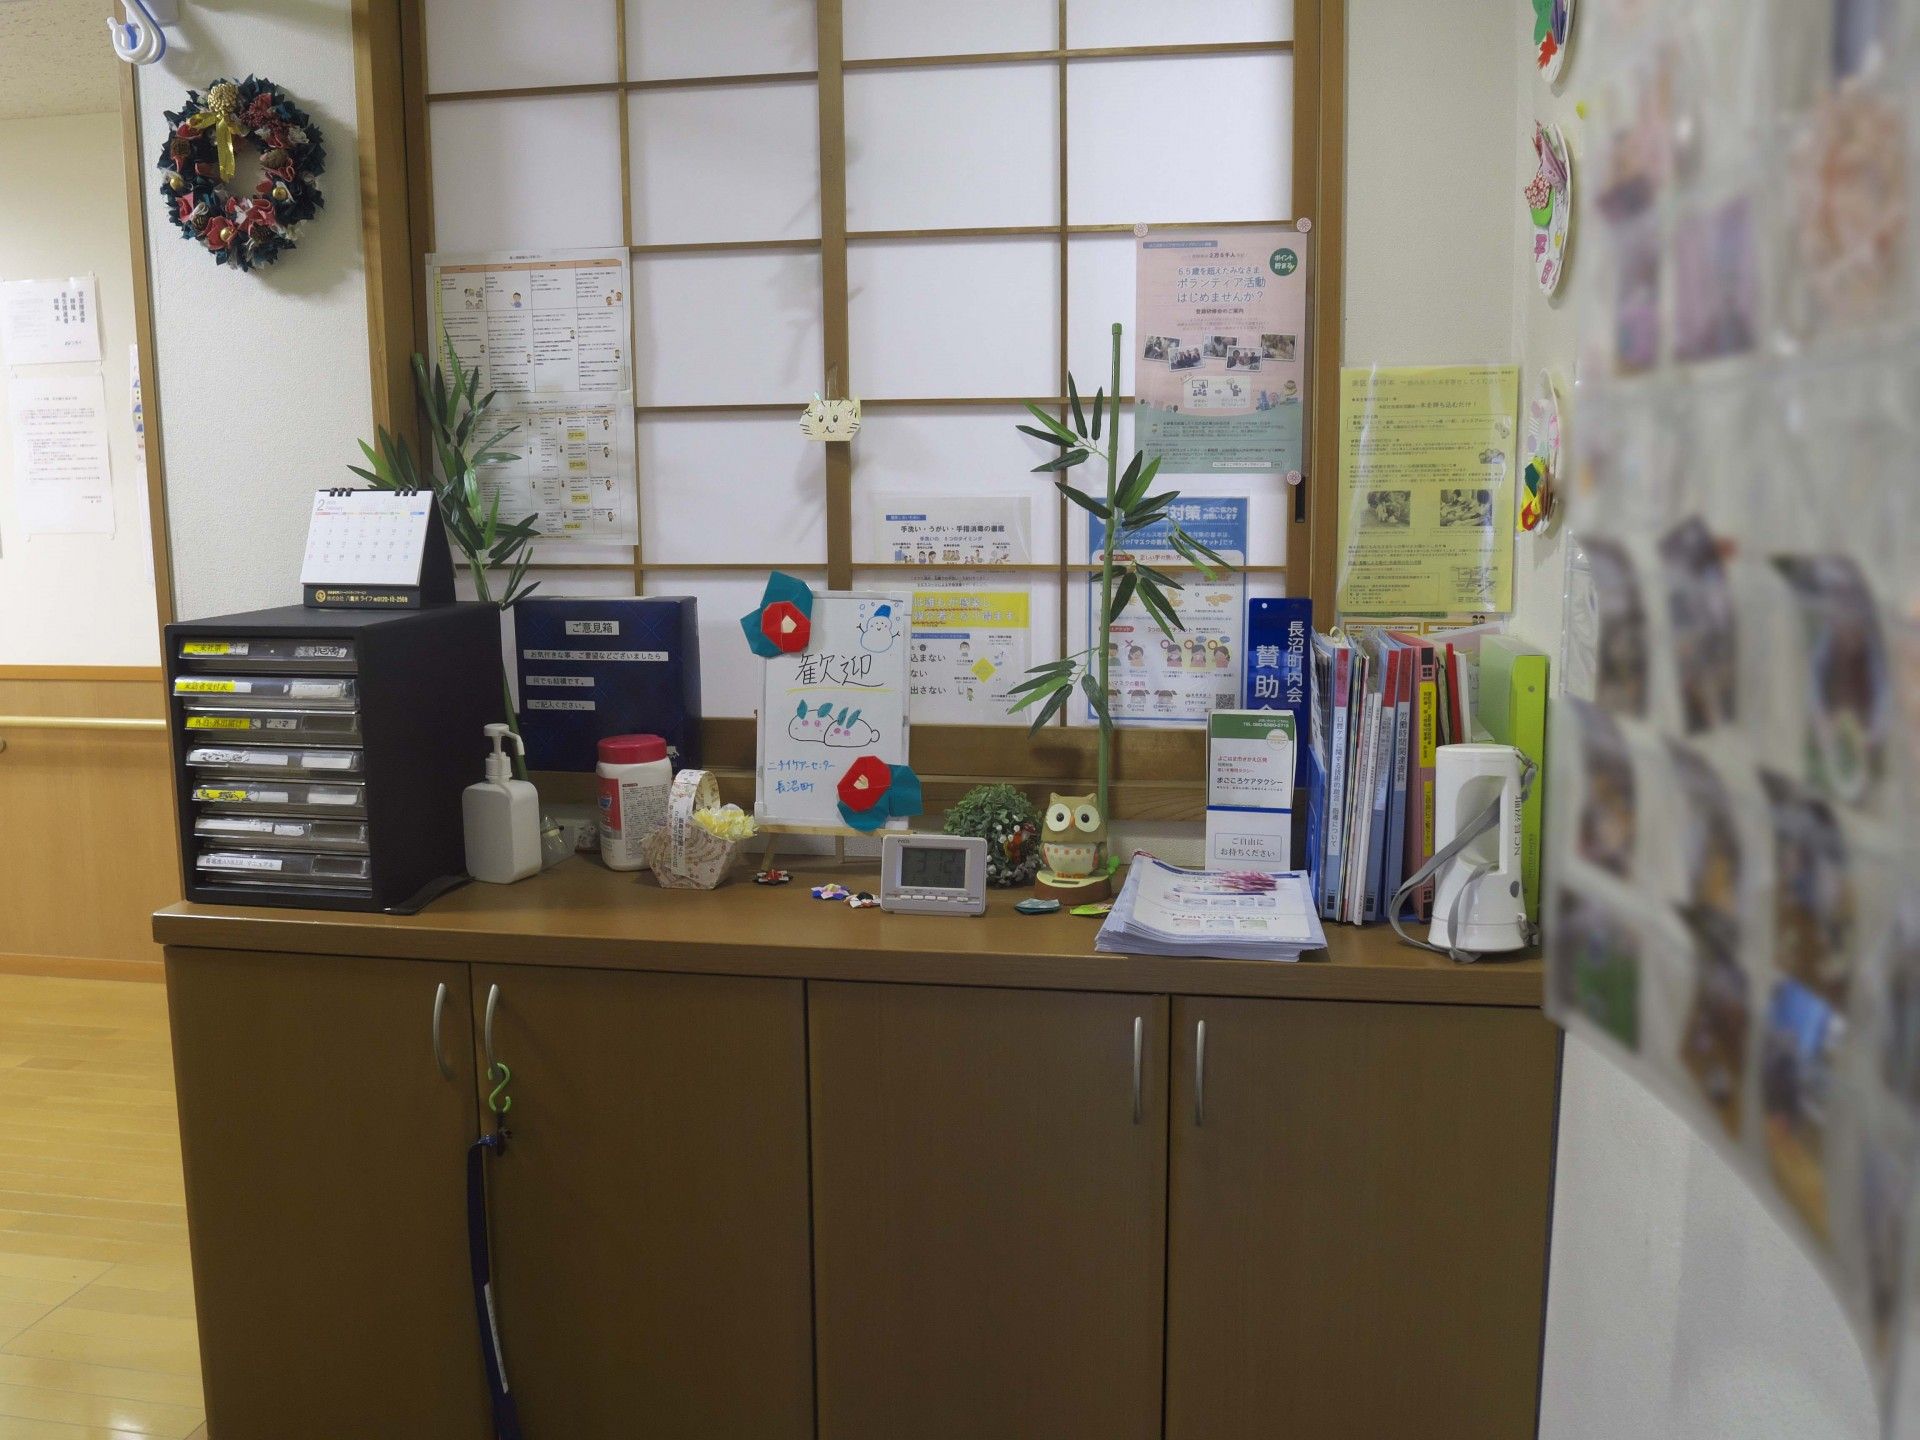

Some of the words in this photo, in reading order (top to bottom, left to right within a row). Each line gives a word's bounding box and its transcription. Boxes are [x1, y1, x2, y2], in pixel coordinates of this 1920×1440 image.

[1177, 276, 1267, 288] ボランティア活動
[316, 498, 326, 512] 2
[571, 622, 614, 635] ご意見箱
[1286, 620, 1306, 704] 長沼町内会
[795, 652, 885, 688] 歓迎
[911, 670, 928, 678] ない
[910, 686, 947, 696] 出さない
[534, 700, 587, 710] ご記入ください。
[774, 779, 815, 795] 長沼町
[1216, 777, 1284, 786] まごころケアタクシー
[1231, 837, 1265, 847] ご自由に
[1220, 846, 1276, 859] お持ちください
